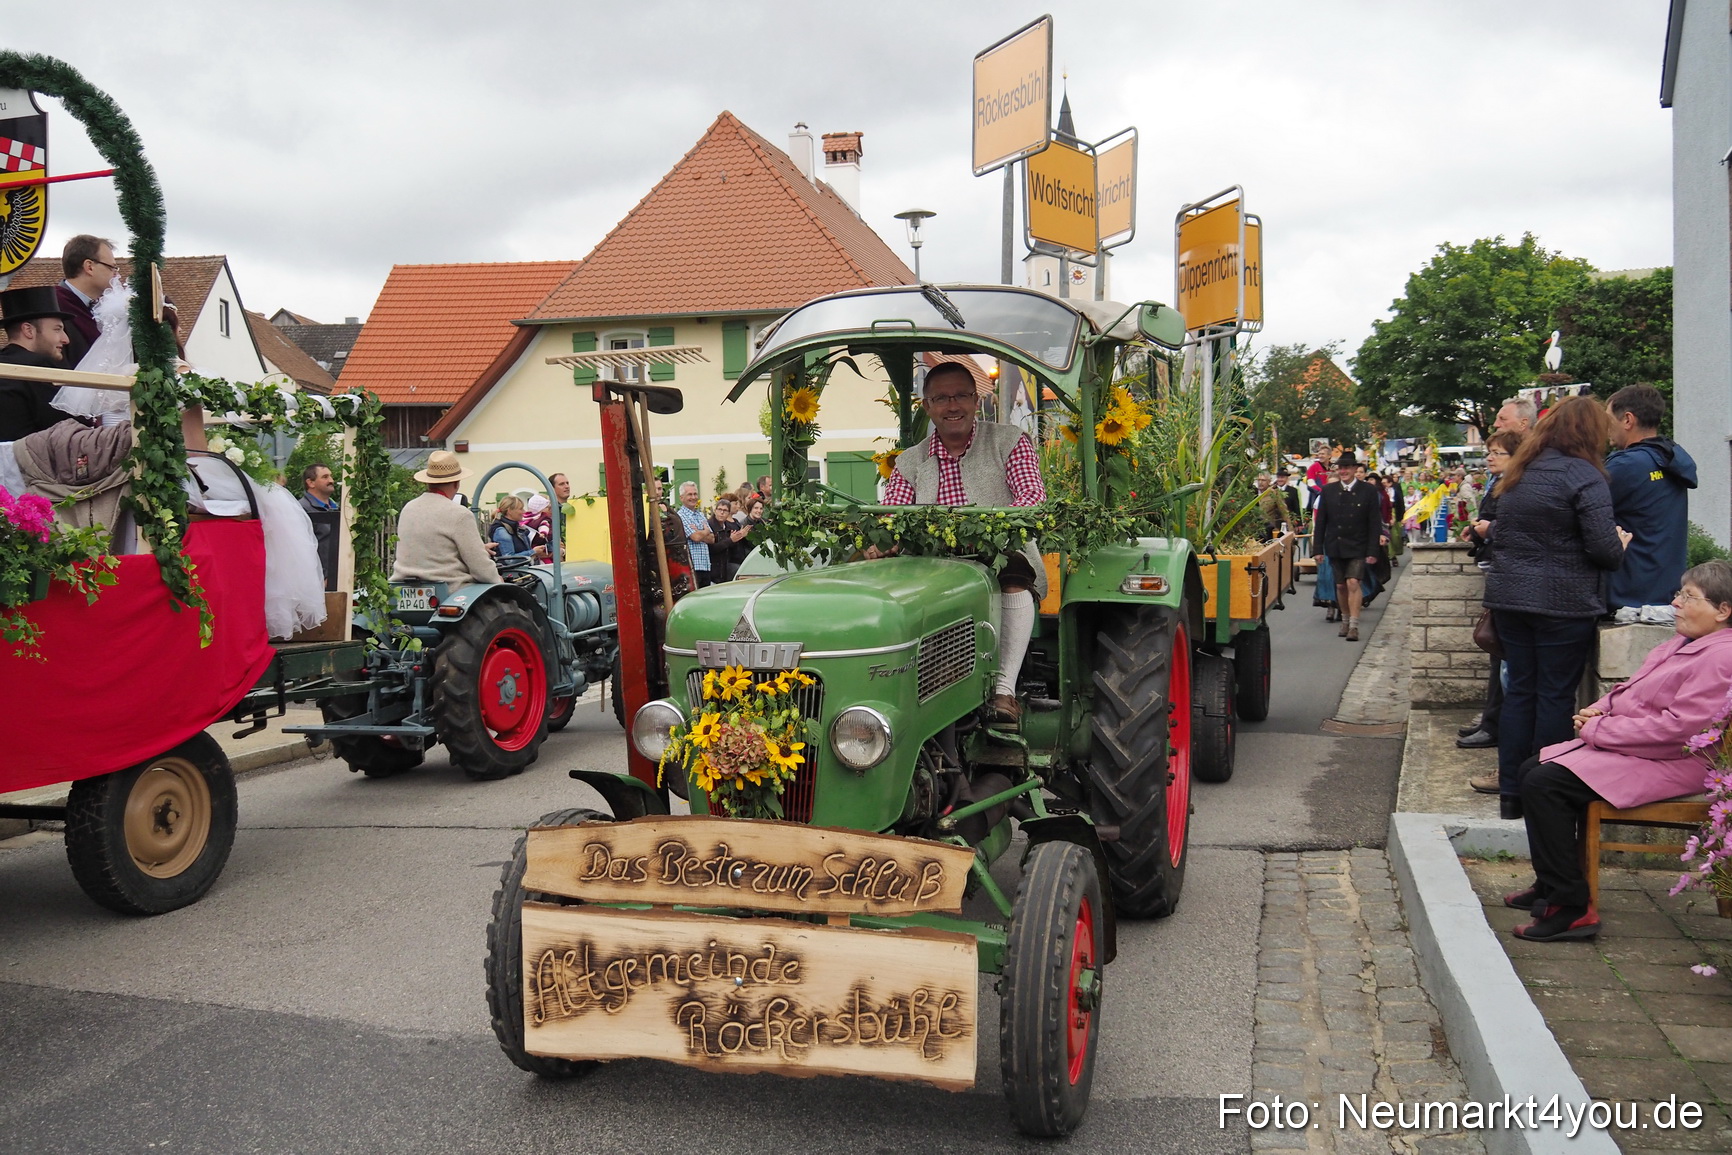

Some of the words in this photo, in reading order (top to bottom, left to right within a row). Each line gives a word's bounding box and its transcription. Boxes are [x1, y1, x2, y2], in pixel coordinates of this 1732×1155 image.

[977, 66, 1045, 130] Röckersbühl
[1030, 170, 1095, 219] Wolfsricht
[1096, 173, 1131, 210] elricht
[1179, 245, 1238, 300] Dippenricht
[399, 599, 412, 610] AP
[413, 599, 425, 610] 40
[403, 588, 417, 599] NM
[697, 642, 801, 669] FENDT
[580, 843, 649, 883] Das
[656, 841, 748, 889] Beste
[751, 863, 813, 901] zum
[817, 853, 945, 907] Schluß
[533, 940, 802, 1024] Altgemeinde
[676, 988, 962, 1062] Röckersbühl
